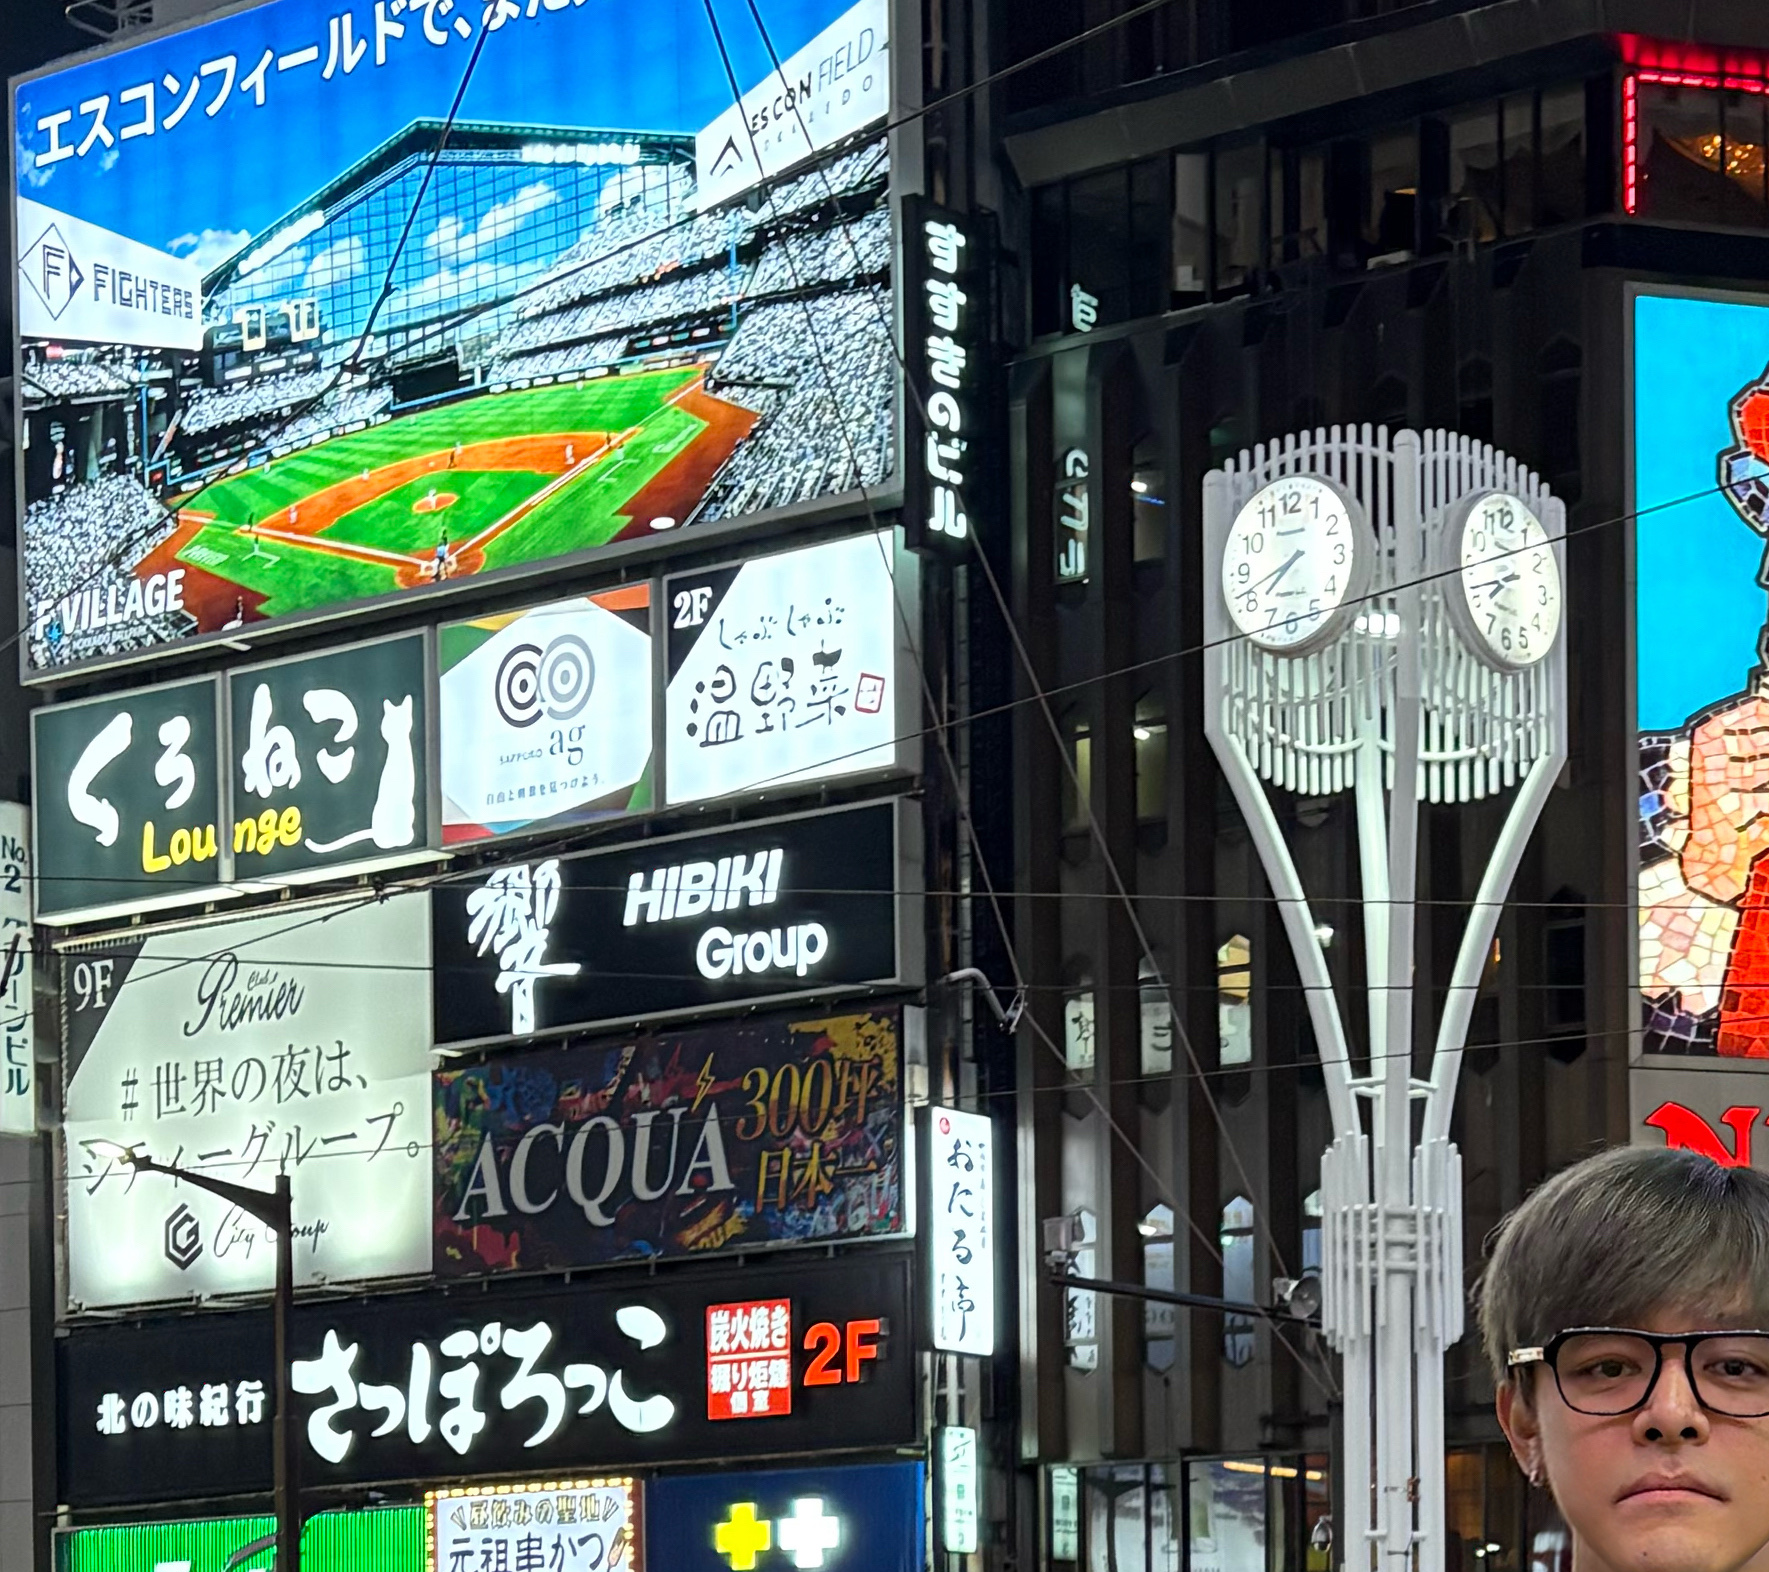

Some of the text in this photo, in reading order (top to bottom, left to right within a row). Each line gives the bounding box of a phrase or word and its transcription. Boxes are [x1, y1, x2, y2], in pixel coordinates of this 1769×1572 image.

[818, 28, 874, 92] FIELD
[94, 262, 194, 320] FIGHTERS
[925, 220, 968, 539] すすきのビル
[1257, 505, 1277, 528] 11
[1279, 492, 1302, 515] 12
[1309, 497, 1319, 519] 1
[1325, 514, 1339, 536] 2
[1242, 532, 1264, 554] 10
[1333, 543, 1346, 565] 3
[1237, 563, 1250, 583] 9
[1324, 575, 1337, 596] 4
[61, 568, 186, 636] VILLAGE
[673, 586, 713, 630] 2F
[719, 597, 846, 650] しゃぶしゃぶ
[1245, 590, 1258, 612] 8
[1264, 607, 1278, 626] 7
[1285, 612, 1298, 634] 6
[1308, 599, 1321, 621] 5
[686, 638, 850, 748] 温野菜
[68, 683, 359, 848] くろねこ
[549, 724, 586, 766] ag
[142, 803, 303, 874] Lounge
[5, 864, 22, 893] 2
[622, 847, 784, 928] HIBIKI
[466, 859, 581, 1035] 響
[696, 921, 829, 982] Group
[73, 959, 115, 1012] 9F
[183, 952, 306, 1037] Premier
[735, 1056, 882, 1141] 300坪
[452, 1102, 735, 1228] ACQUA
[755, 1141, 877, 1213] 日本一
[709, 1304, 789, 1352] 炭火焼き
[803, 1318, 880, 1386] 2F
[96, 1378, 267, 1435] 北の味紀行
[291, 1305, 675, 1463] さっぽろっこ
